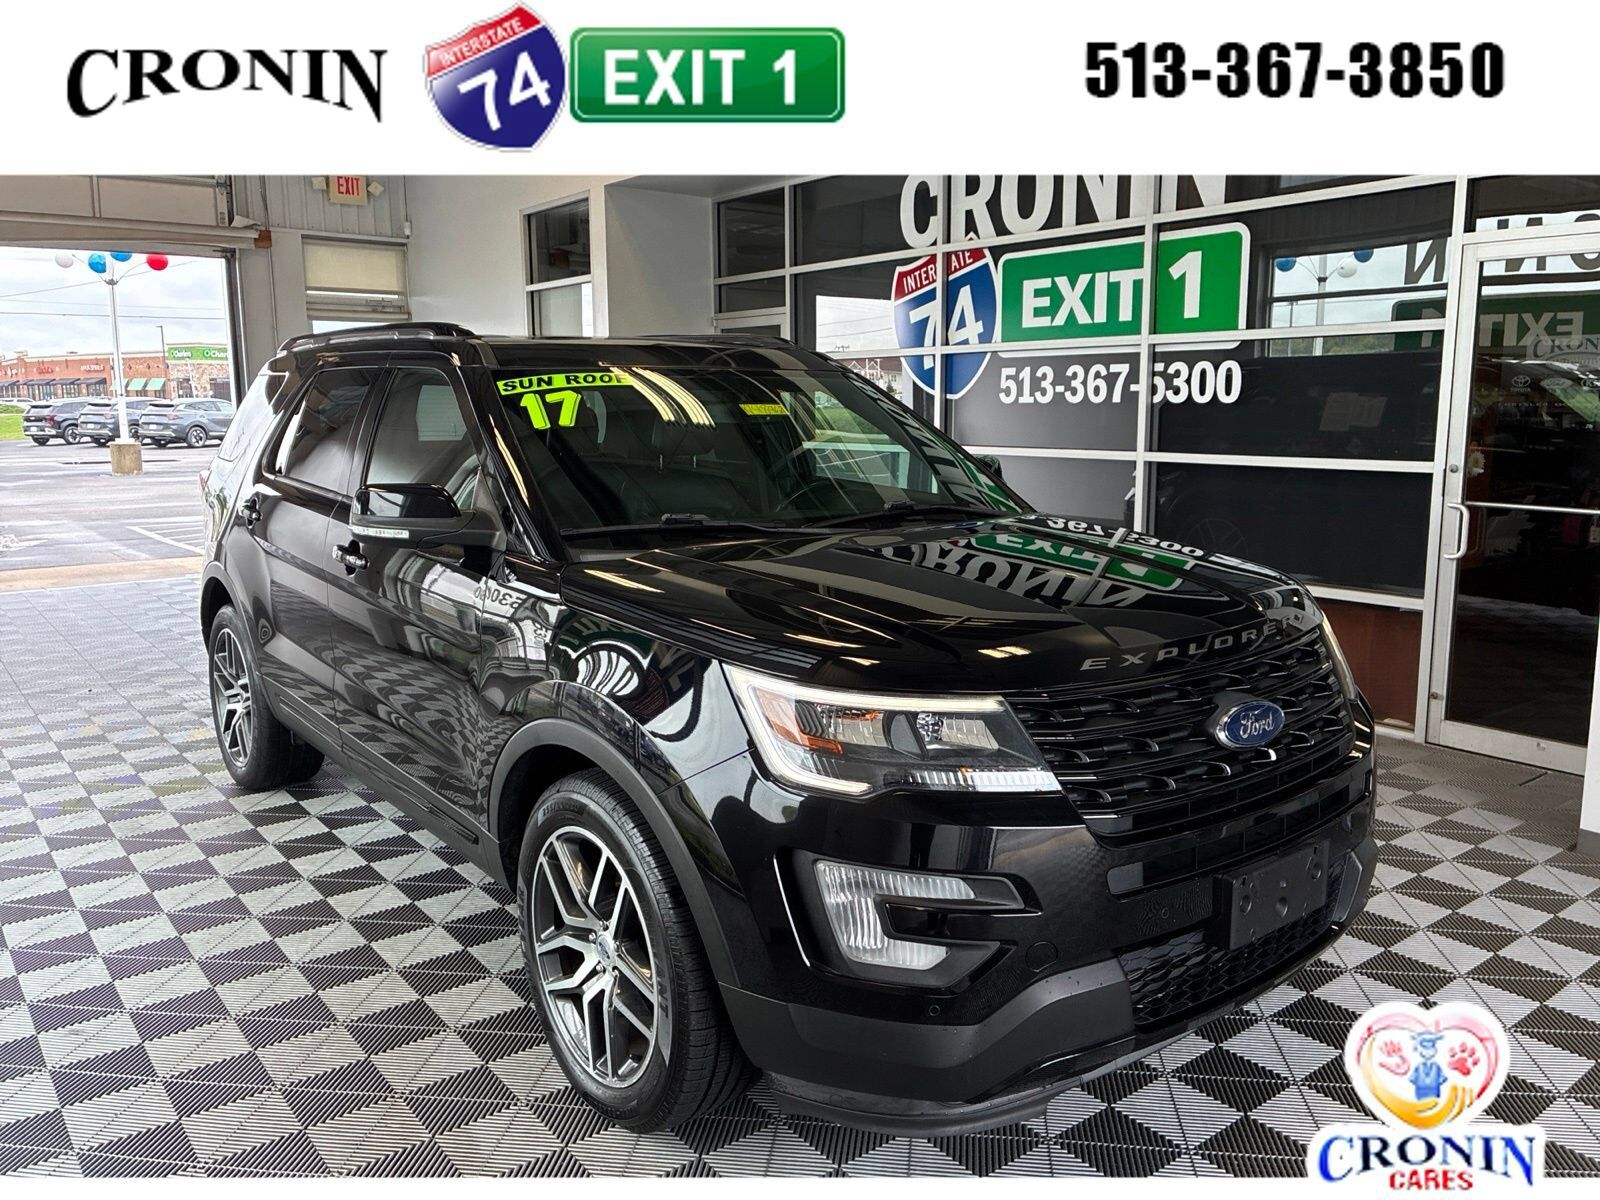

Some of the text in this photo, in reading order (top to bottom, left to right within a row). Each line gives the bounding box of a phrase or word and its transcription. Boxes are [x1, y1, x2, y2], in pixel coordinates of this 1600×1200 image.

[336, 176, 361, 196] EXIT
[901, 175, 1227, 250] CRONIN
[1022, 250, 1203, 328] EXIT 1
[908, 284, 985, 371] 74
[502, 375, 554, 392] SUN
[999, 360, 1242, 404] 513-367-5300
[520, 389, 581, 430] 17
[1239, 707, 1276, 739] Ford
